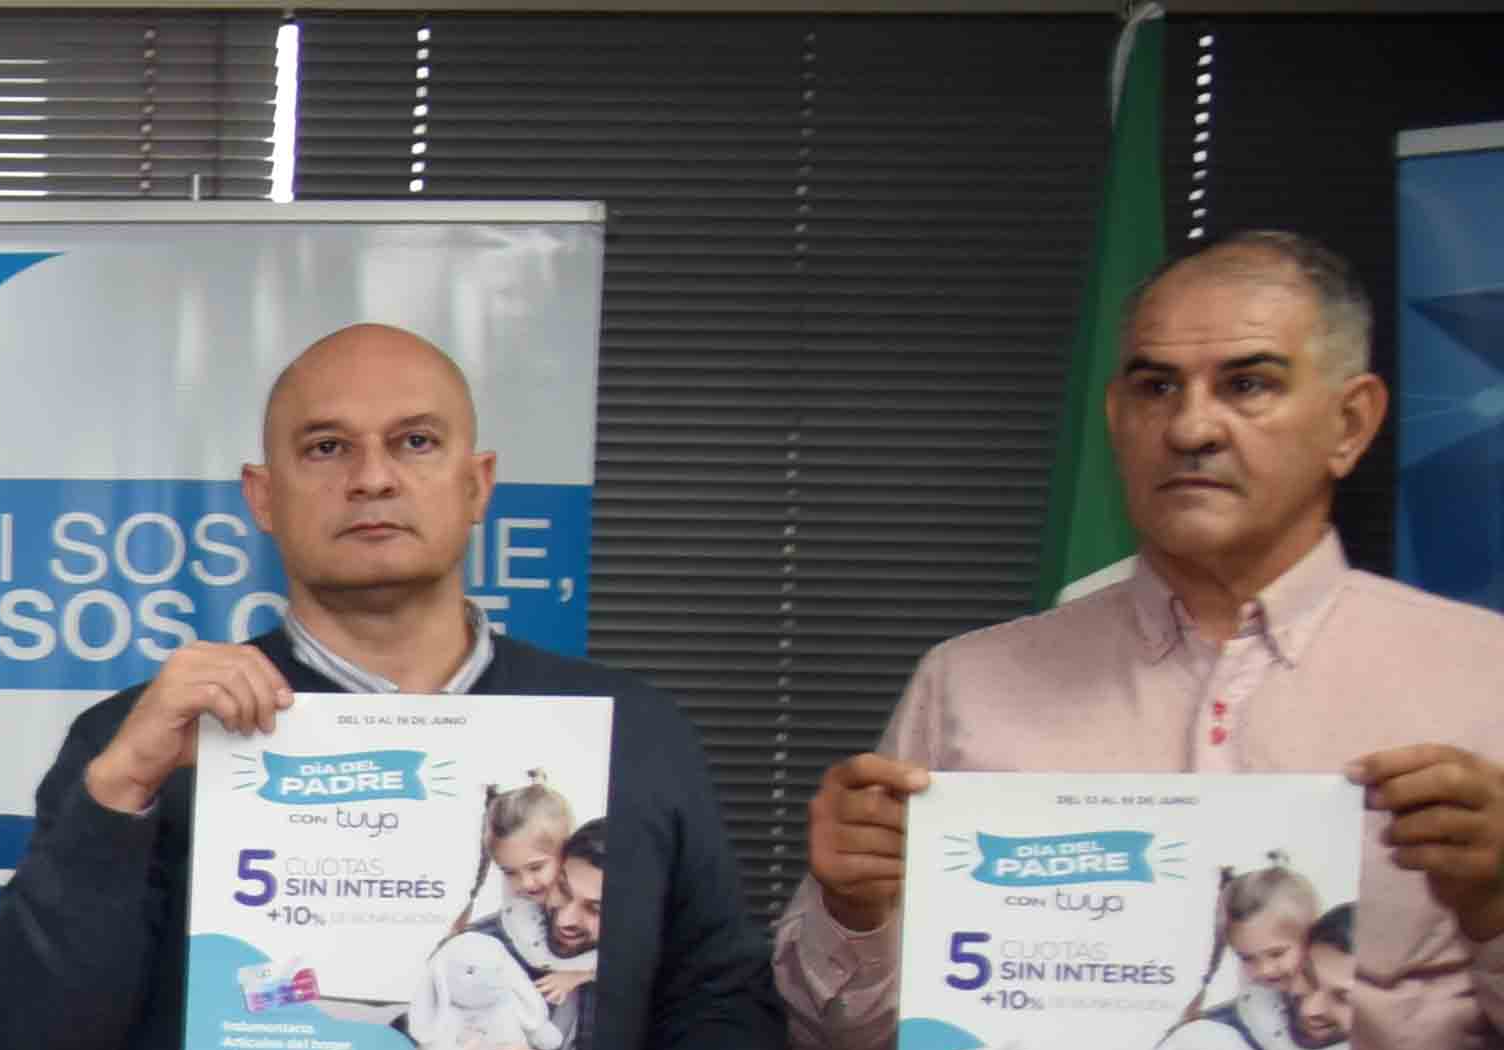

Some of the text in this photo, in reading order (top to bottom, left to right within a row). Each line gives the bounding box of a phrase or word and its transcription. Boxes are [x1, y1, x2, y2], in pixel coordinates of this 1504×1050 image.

[50, 512, 250, 585] SOS
[279, 767, 403, 797] PADRE
[299, 759, 381, 776] DÍA DEL
[995, 849, 1129, 880] PADRE
[1016, 841, 1105, 858] DÍA DEL
[233, 848, 278, 906] 5
[285, 872, 446, 899] SIN INTERÉS
[945, 931, 993, 991] 5
[1000, 956, 1176, 985] SIN INTERÉS
